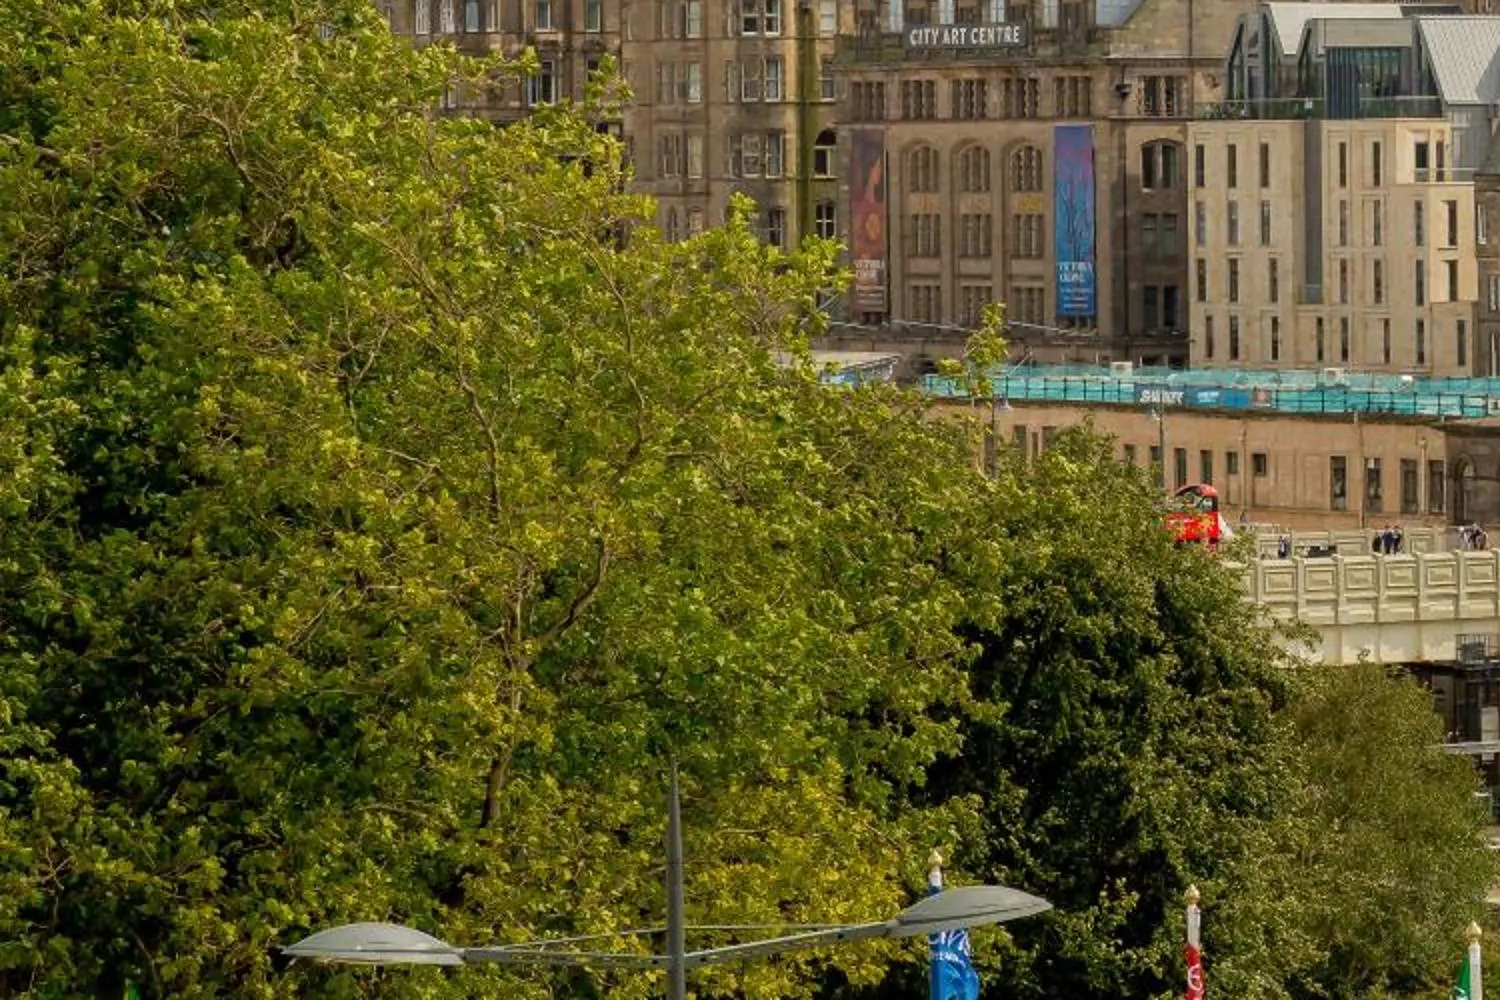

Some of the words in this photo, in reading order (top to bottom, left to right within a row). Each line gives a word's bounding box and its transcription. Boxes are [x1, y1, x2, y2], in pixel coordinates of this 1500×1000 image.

[910, 27, 939, 46] CITY
[942, 27, 967, 45] ART
[971, 25, 1020, 44] CENTRE
